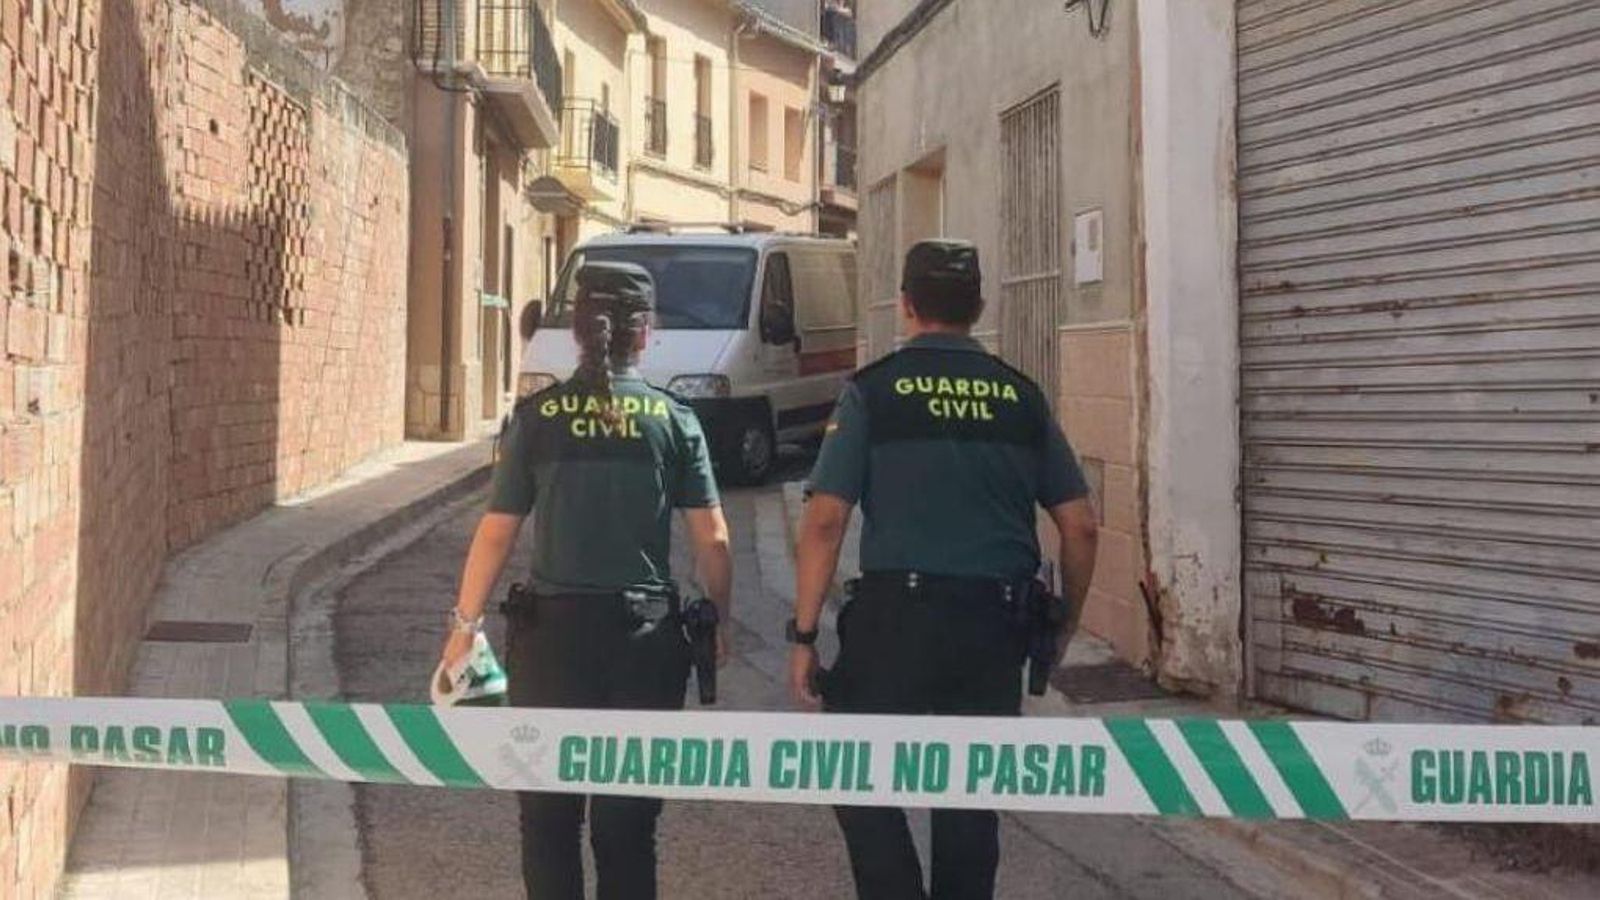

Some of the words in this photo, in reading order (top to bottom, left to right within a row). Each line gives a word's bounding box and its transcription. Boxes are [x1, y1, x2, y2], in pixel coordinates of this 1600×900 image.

[895, 376, 1019, 402] GUARDIA
[928, 398, 994, 420] CIVIL
[571, 418, 643, 439] CIVIL
[70, 724, 226, 767] PASAR
[557, 735, 752, 789] GUARDIA
[767, 738, 875, 793] CIVIL
[891, 741, 953, 794] NO
[965, 742, 1108, 796] PASAR
[1410, 749, 1593, 806] GUARDIA
